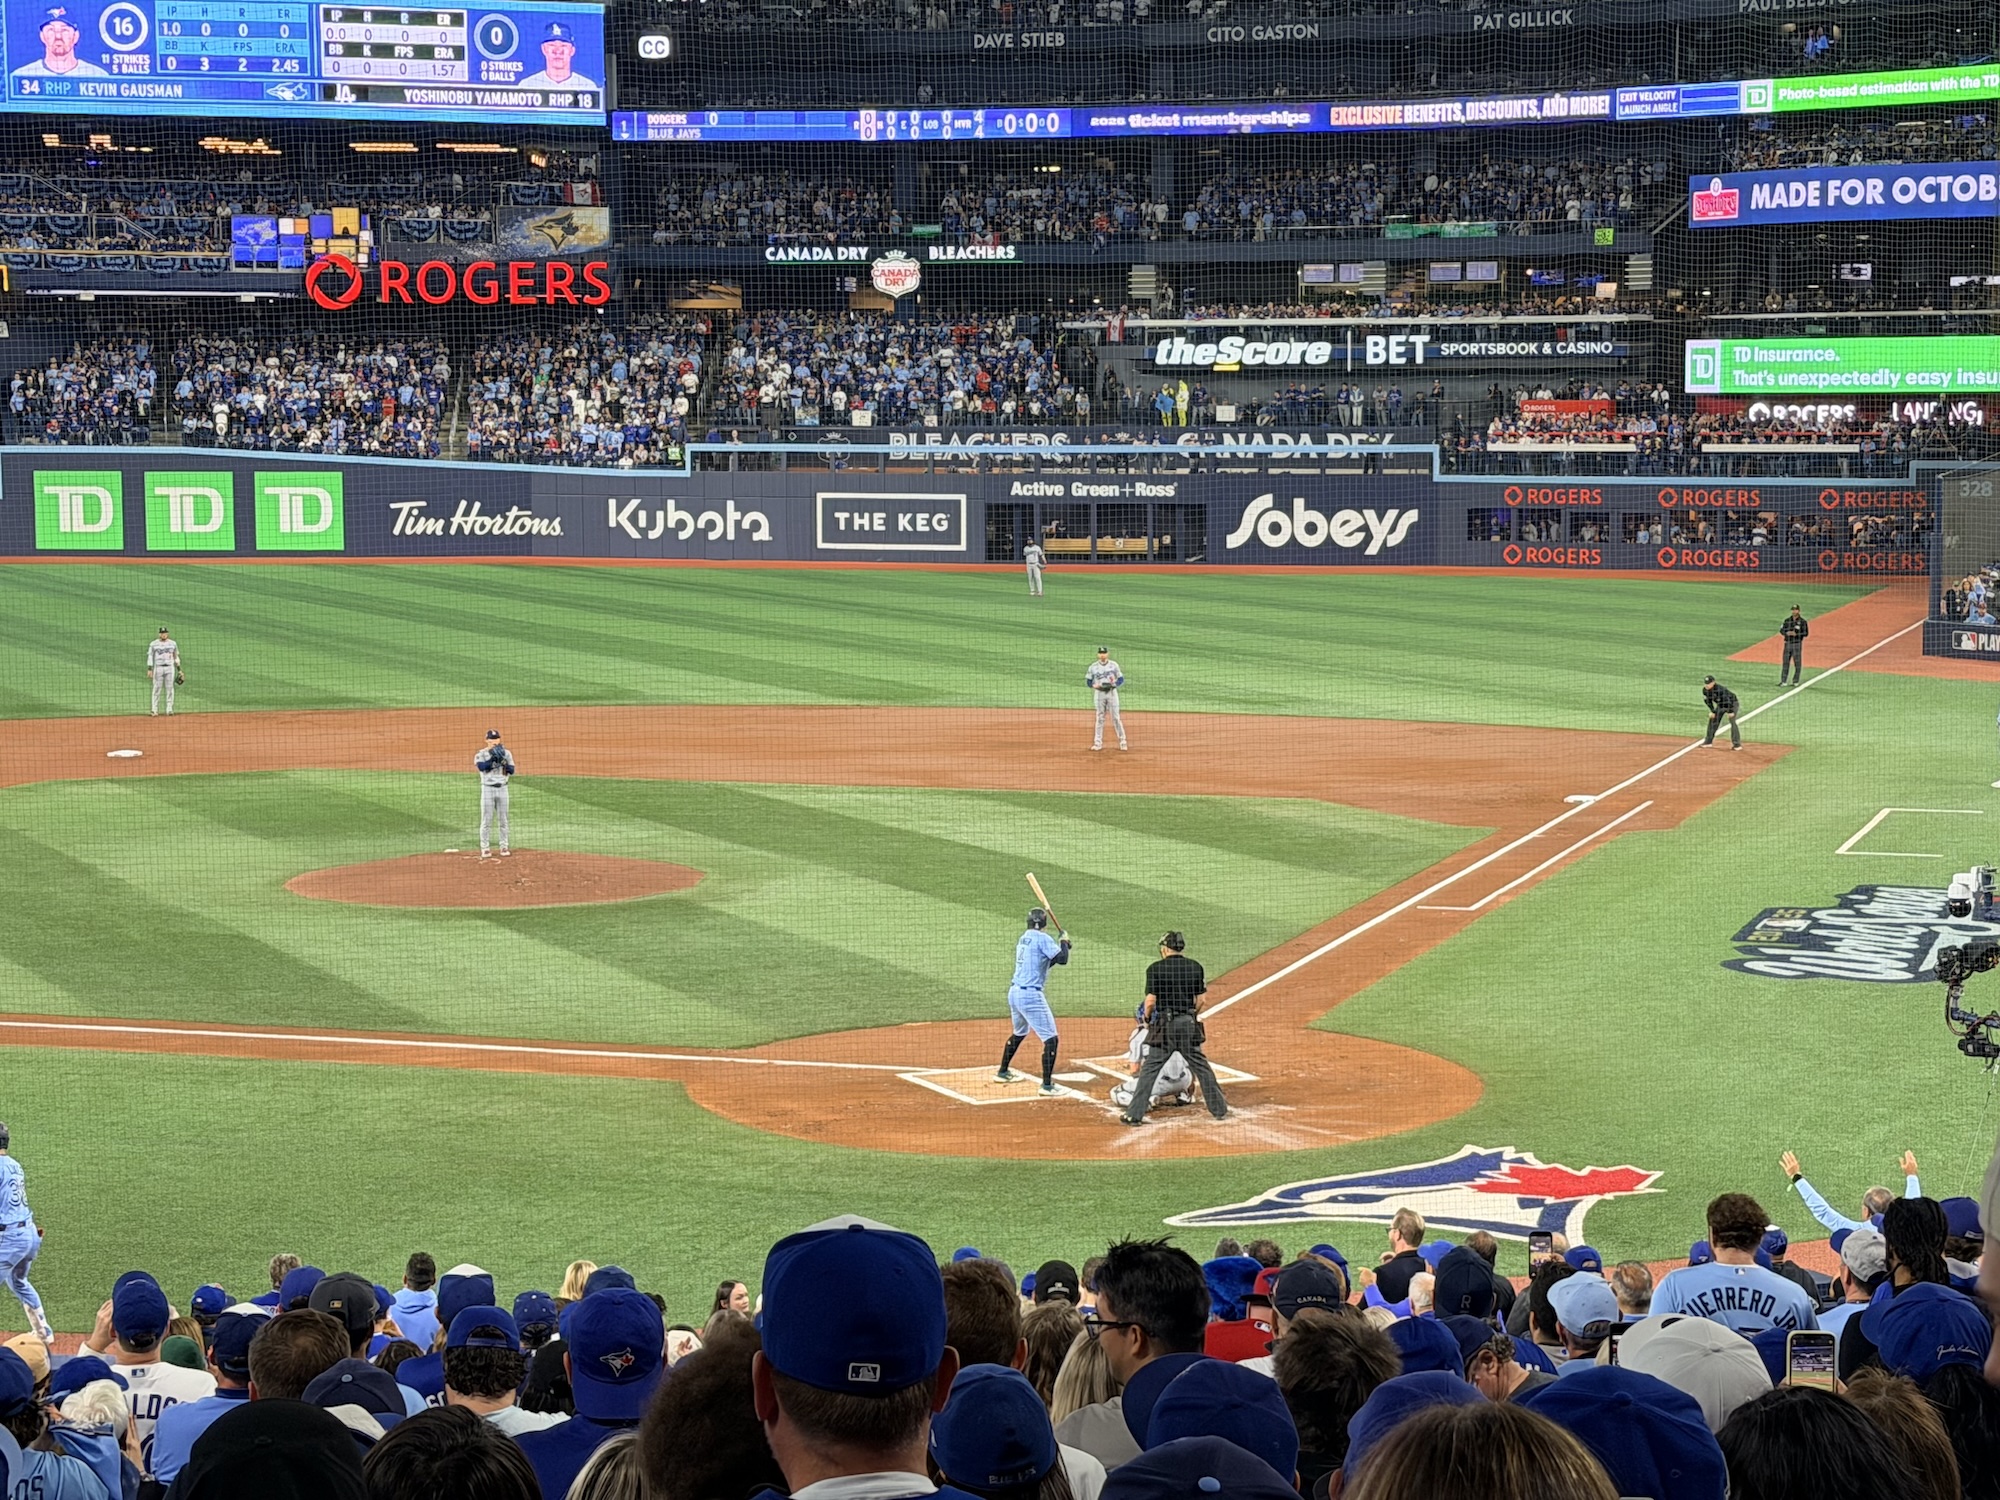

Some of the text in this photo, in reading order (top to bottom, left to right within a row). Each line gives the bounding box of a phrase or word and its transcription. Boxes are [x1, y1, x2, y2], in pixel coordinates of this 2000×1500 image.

[167, 6, 290, 19] IP H R ER
[331, 12, 451, 25] IP H ER
[1473, 10, 1574, 30] PAT GILLICK
[113, 17, 133, 36] 16
[162, 22, 289, 38] 1.0 0 0 0
[1207, 24, 1319, 42] CITO GASTON
[326, 28, 447, 43] 0.0 0 0 0
[491, 27, 502, 46] 0
[974, 33, 1065, 49] DAVE STIEB
[165, 41, 295, 53] BB K FPS ERA
[329, 44, 454, 59] BB K FPS ERA
[643, 40, 665, 55] CC
[101, 54, 150, 64] 11 STRIKES
[167, 56, 299, 73] 0 3 2 2.45
[481, 61, 523, 73] 0 STRIKES
[112, 64, 150, 74] 5 BALLS
[332, 61, 455, 77] 0 0 0 1.57
[481, 71, 515, 81] 0 BALLS
[21, 81, 182, 98] 34 RHP KEVIN GAUSMAN
[404, 89, 472, 105] YOSHINOBU
[475, 91, 542, 107] YAMAMOTO
[549, 95, 573, 107] RHP
[578, 94, 592, 107] 18
[1620, 90, 1676, 103] EXIT VELOCITY
[1749, 75, 1999, 105] TD Photo-based estimation with the TD
[1330, 95, 1610, 126] EXCLUSIVE BENEFITS, DISCOUNTS, AND MORE!
[1620, 102, 1678, 115] LAUNCH ANGLE
[621, 120, 627, 132] 1
[647, 111, 718, 126] DODGERS 0
[865, 112, 872, 125] 0
[887, 111, 895, 124] 0
[911, 111, 919, 124] 0
[942, 111, 951, 124] 0
[974, 111, 984, 123] 4
[1004, 114, 1016, 134] 0
[1025, 113, 1038, 133] 0
[1046, 113, 1059, 133] 0
[1128, 114, 1180, 127] ticket
[1182, 111, 1311, 127] memberships
[648, 128, 701, 139] BLUE JAYS
[865, 125, 984, 139] 0 0 0 0 4
[1751, 181, 1820, 210] MADE
[1828, 178, 1884, 207] FOR
[1892, 174, 2000, 205] OCTOB
[765, 246, 1015, 261] CANADA DRY BLEACHERS
[873, 268, 920, 278] CANADA
[381, 260, 611, 305] ROGERS
[884, 277, 907, 287] DRY
[1155, 335, 1613, 365] theScore BET SPORTSBOOK & CASINO
[1692, 347, 1840, 379] TD TD Insurance.
[1733, 368, 2000, 389] That's unexpectedly easy insu
[1010, 481, 1065, 497] Active
[1527, 488, 1602, 505] ROGERS
[1960, 480, 1993, 497] 328
[1683, 489, 1760, 507] ROGERS
[1844, 491, 1927, 507] ROGERS
[44, 486, 113, 532] TD
[155, 487, 224, 532] TD
[264, 487, 333, 533] TD
[389, 500, 443, 536] Tim
[608, 498, 772, 541] Kubota
[834, 511, 951, 533] THE KEG
[1226, 493, 1419, 556] Sobeys
[1526, 547, 1601, 565] ROGERS
[1682, 549, 1760, 567] ROGERS
[1844, 552, 1925, 570] ROGERS
[1296, 1295, 1327, 1304] CANADA
[1460, 1295, 1471, 1309] R
[1679, 1286, 1776, 1319] UERRERO
